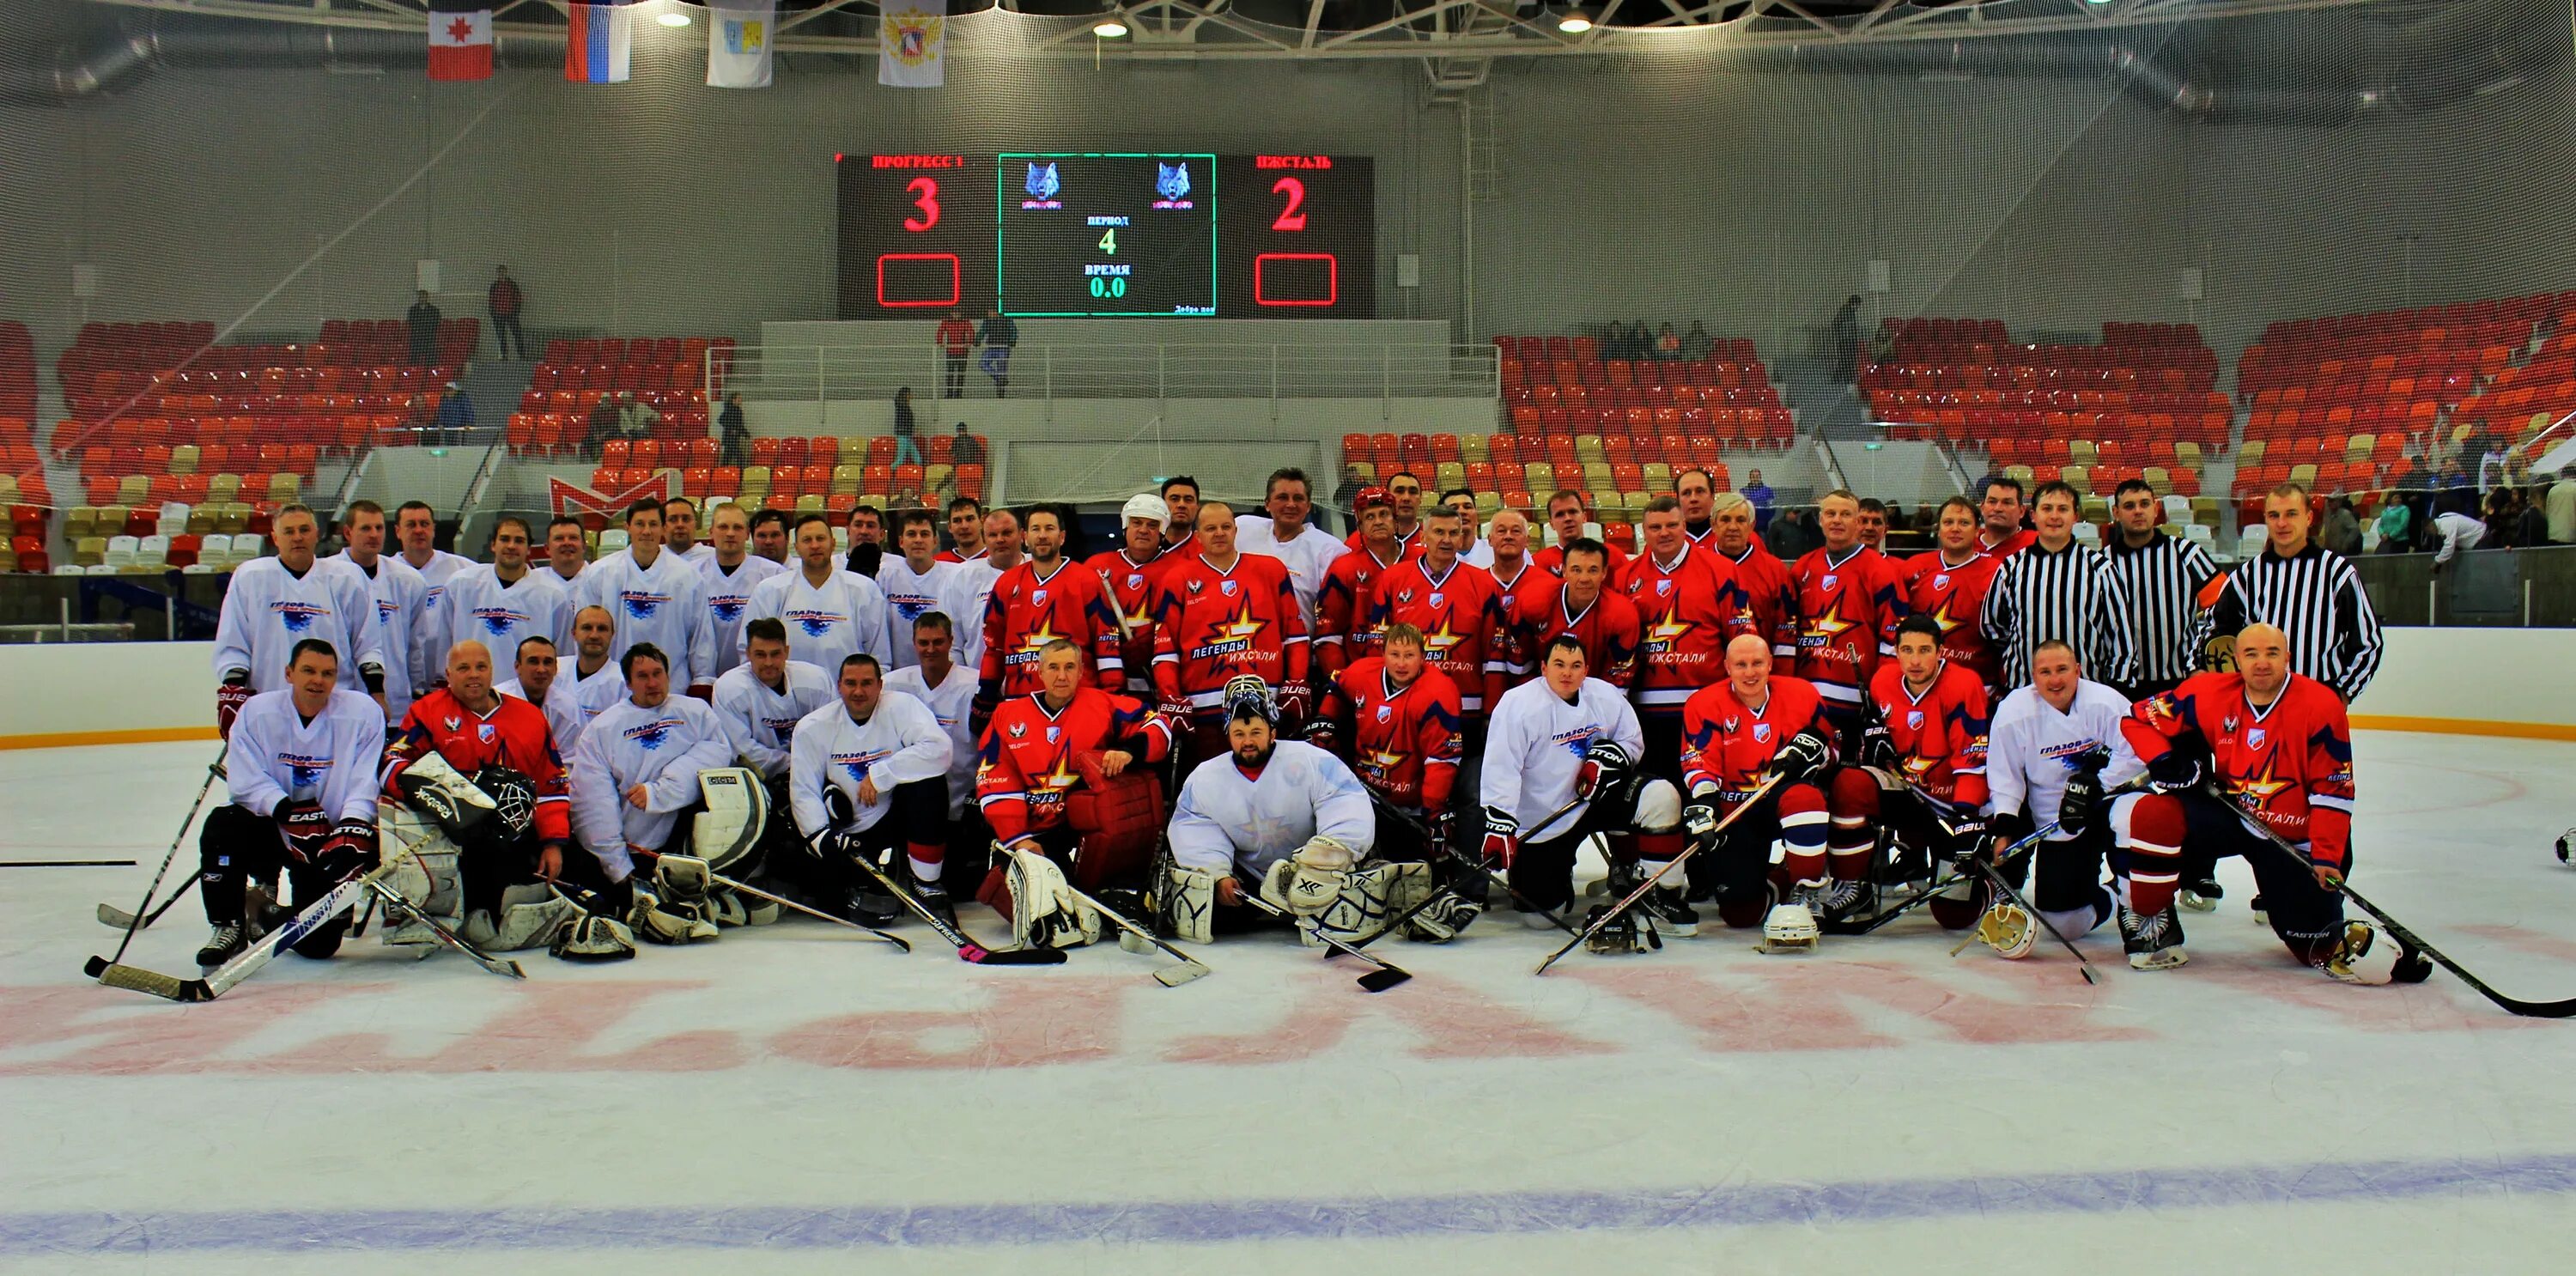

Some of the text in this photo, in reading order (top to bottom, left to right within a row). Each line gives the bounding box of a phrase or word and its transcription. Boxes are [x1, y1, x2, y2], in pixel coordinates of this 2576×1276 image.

[903, 177, 940, 232] 3
[1272, 177, 1307, 231] 2
[1087, 216, 1129, 226] ПЕРИОД
[1098, 228, 1116, 254] 4
[1084, 264, 1130, 275] ВРЕМЯ
[1090, 276, 1125, 298] 0.0
[1192, 641, 1245, 659] ЛЕГЕНДЫ
[2040, 740, 2082, 755] ГЛАЗОВ
[414, 788, 453, 819] Reebok
[330, 826, 373, 837] STON
[2287, 930, 2330, 939] EASTON
